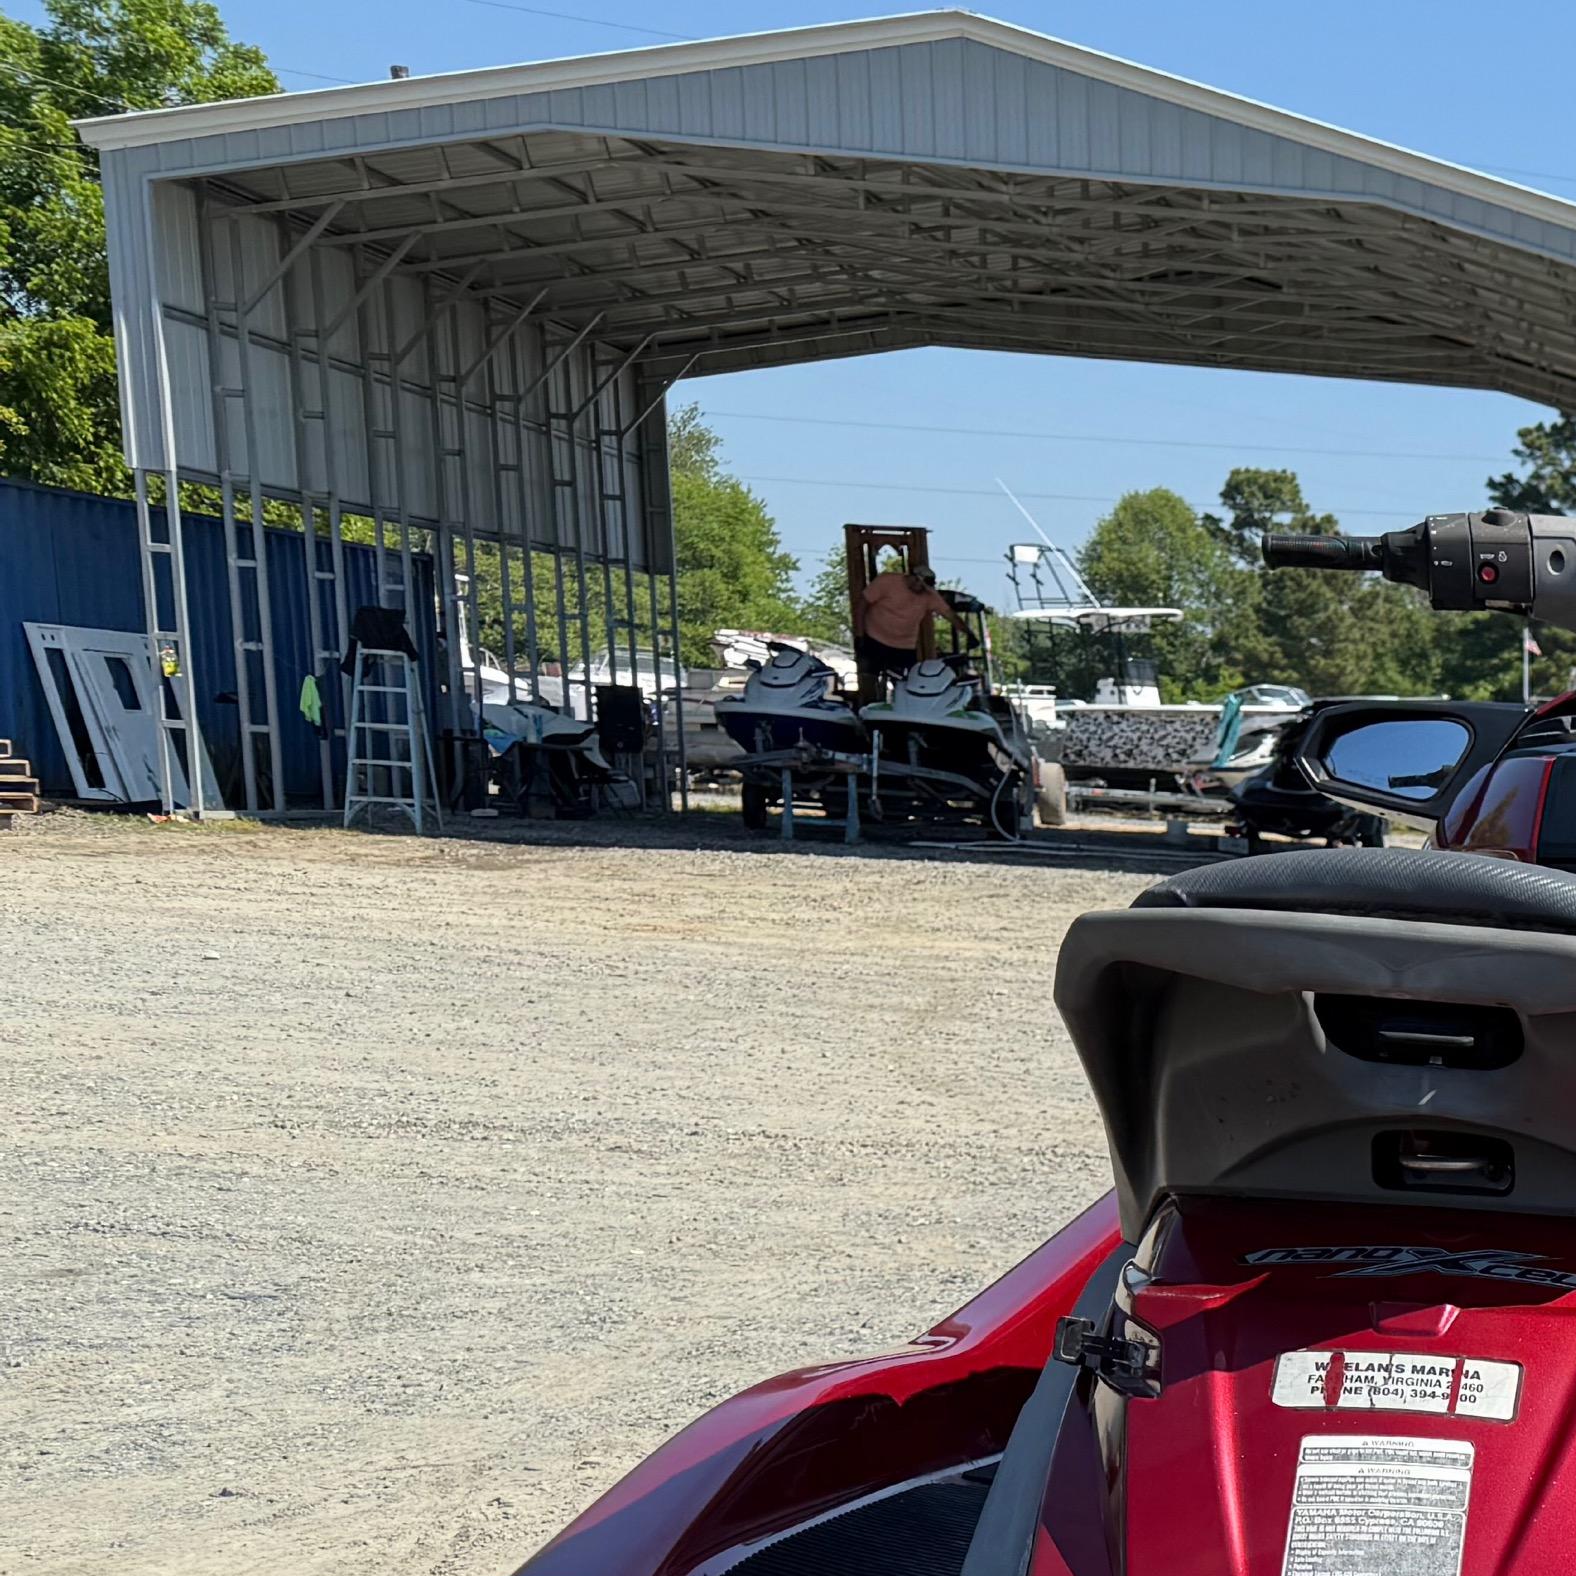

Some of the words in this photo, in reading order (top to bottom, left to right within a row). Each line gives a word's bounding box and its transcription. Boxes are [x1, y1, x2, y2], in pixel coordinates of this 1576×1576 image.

[1307, 1374, 1377, 1386] FAHAM,
[1446, 1381, 1484, 1393] 2460
[1410, 1389, 1477, 1404] 394-900
